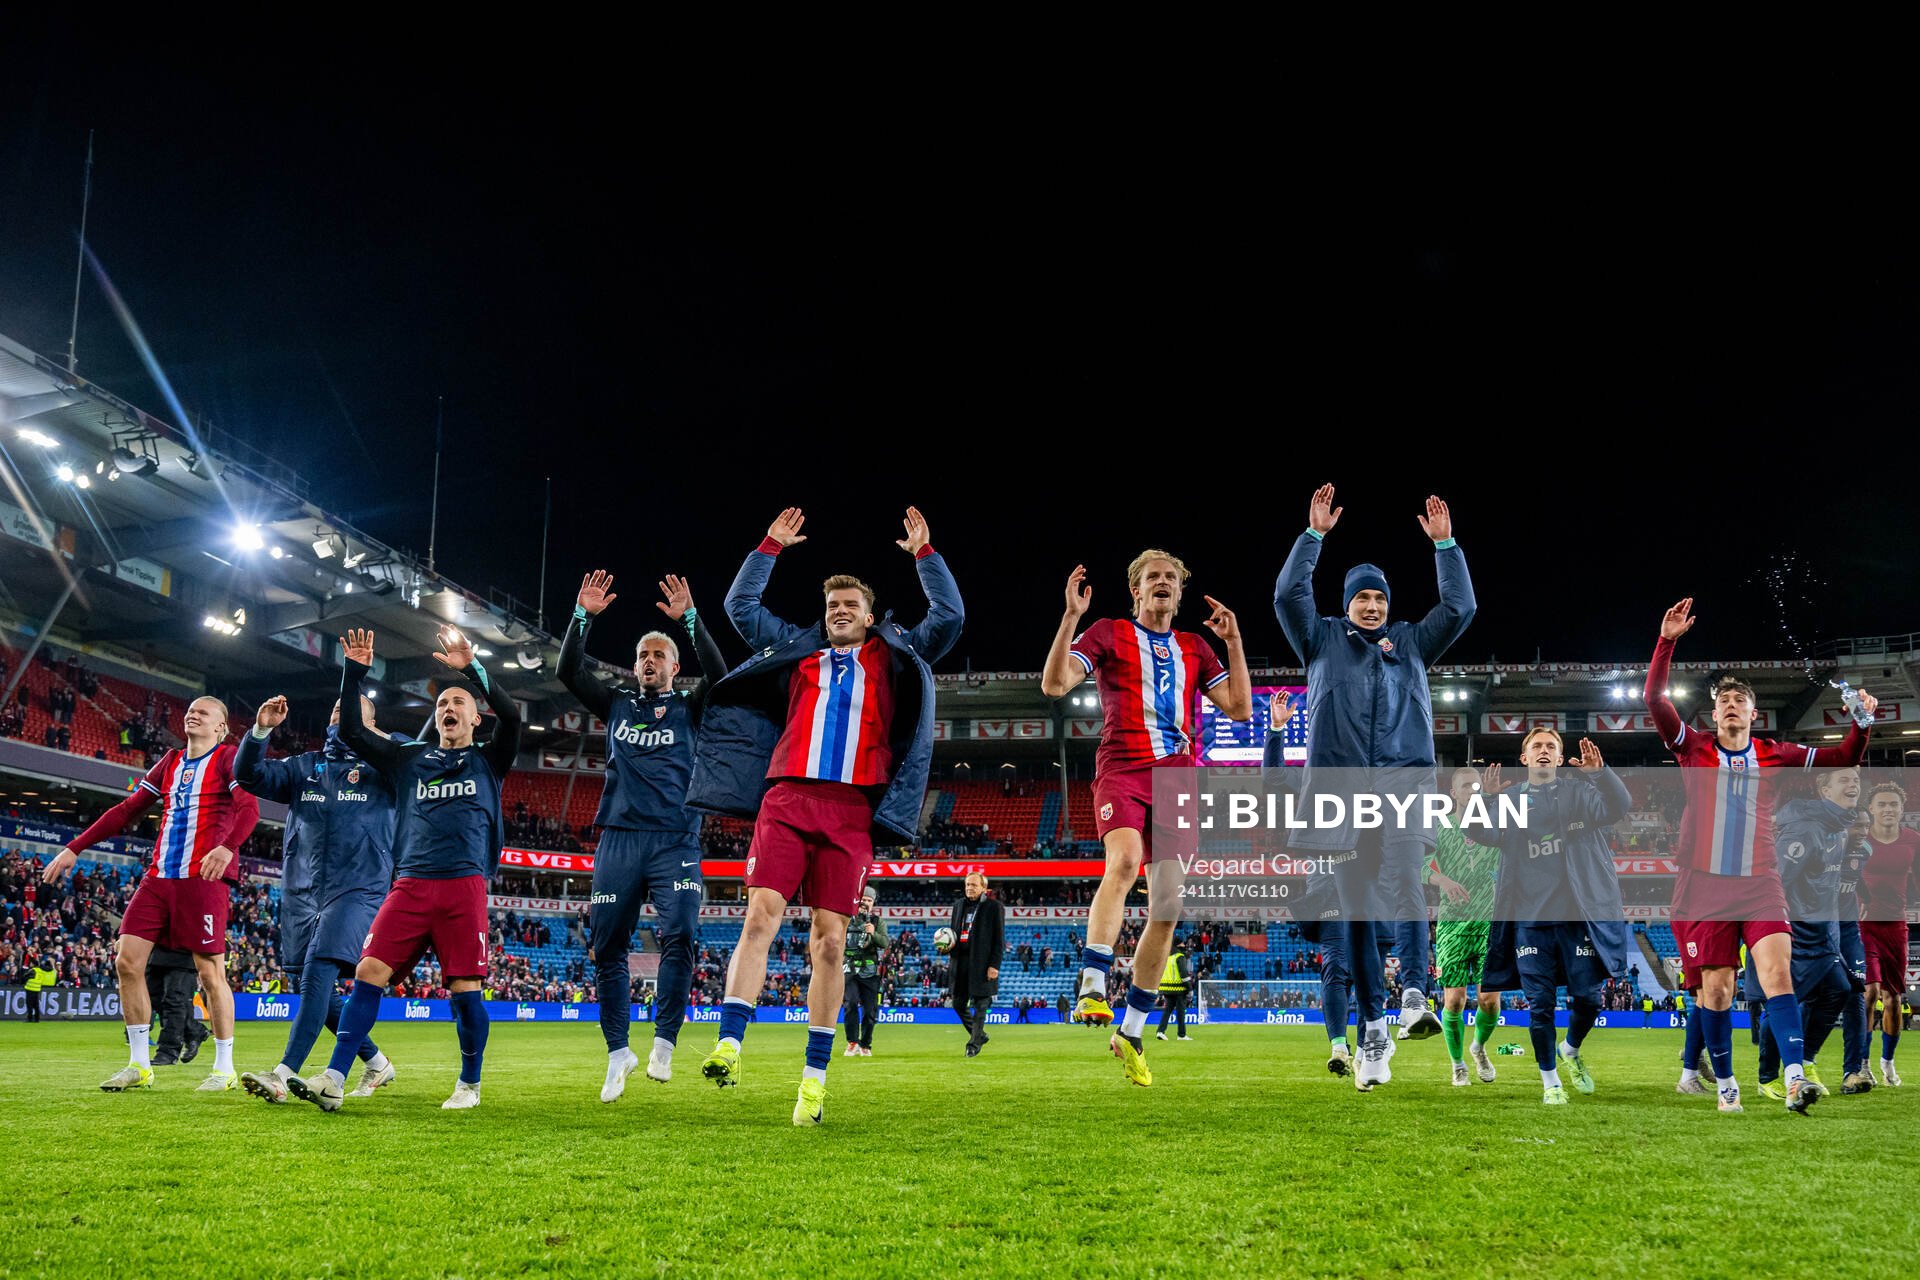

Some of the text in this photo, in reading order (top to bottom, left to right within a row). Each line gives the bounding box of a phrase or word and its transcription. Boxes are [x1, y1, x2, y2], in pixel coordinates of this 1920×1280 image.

[837, 665, 848, 685] 7
[1160, 669, 1170, 695] 2
[979, 721, 1104, 737] VG V
[1490, 715, 1555, 731] VG
[1732, 775, 1743, 796] 11
[41, 830, 61, 841] Tipping
[93, 841, 115, 850] ipping
[1528, 839, 1562, 859] bam
[528, 853, 572, 868] VG
[888, 864, 937, 875] VG
[496, 898, 521, 907] VG
[529, 901, 559, 910] VG
[891, 908, 923, 917] VG
[1014, 908, 1088, 916] VG VG
[1185, 908, 1216, 917] VG
[1320, 909, 1339, 919] ama
[204, 915, 213, 936] 9
[479, 932, 486, 957] 4
[66, 992, 124, 1016] LEAG
[694, 1008, 720, 1021] bam
[785, 1009, 809, 1021] bam
[984, 1012, 1010, 1023] ma
[1467, 1010, 1505, 1025] ba
